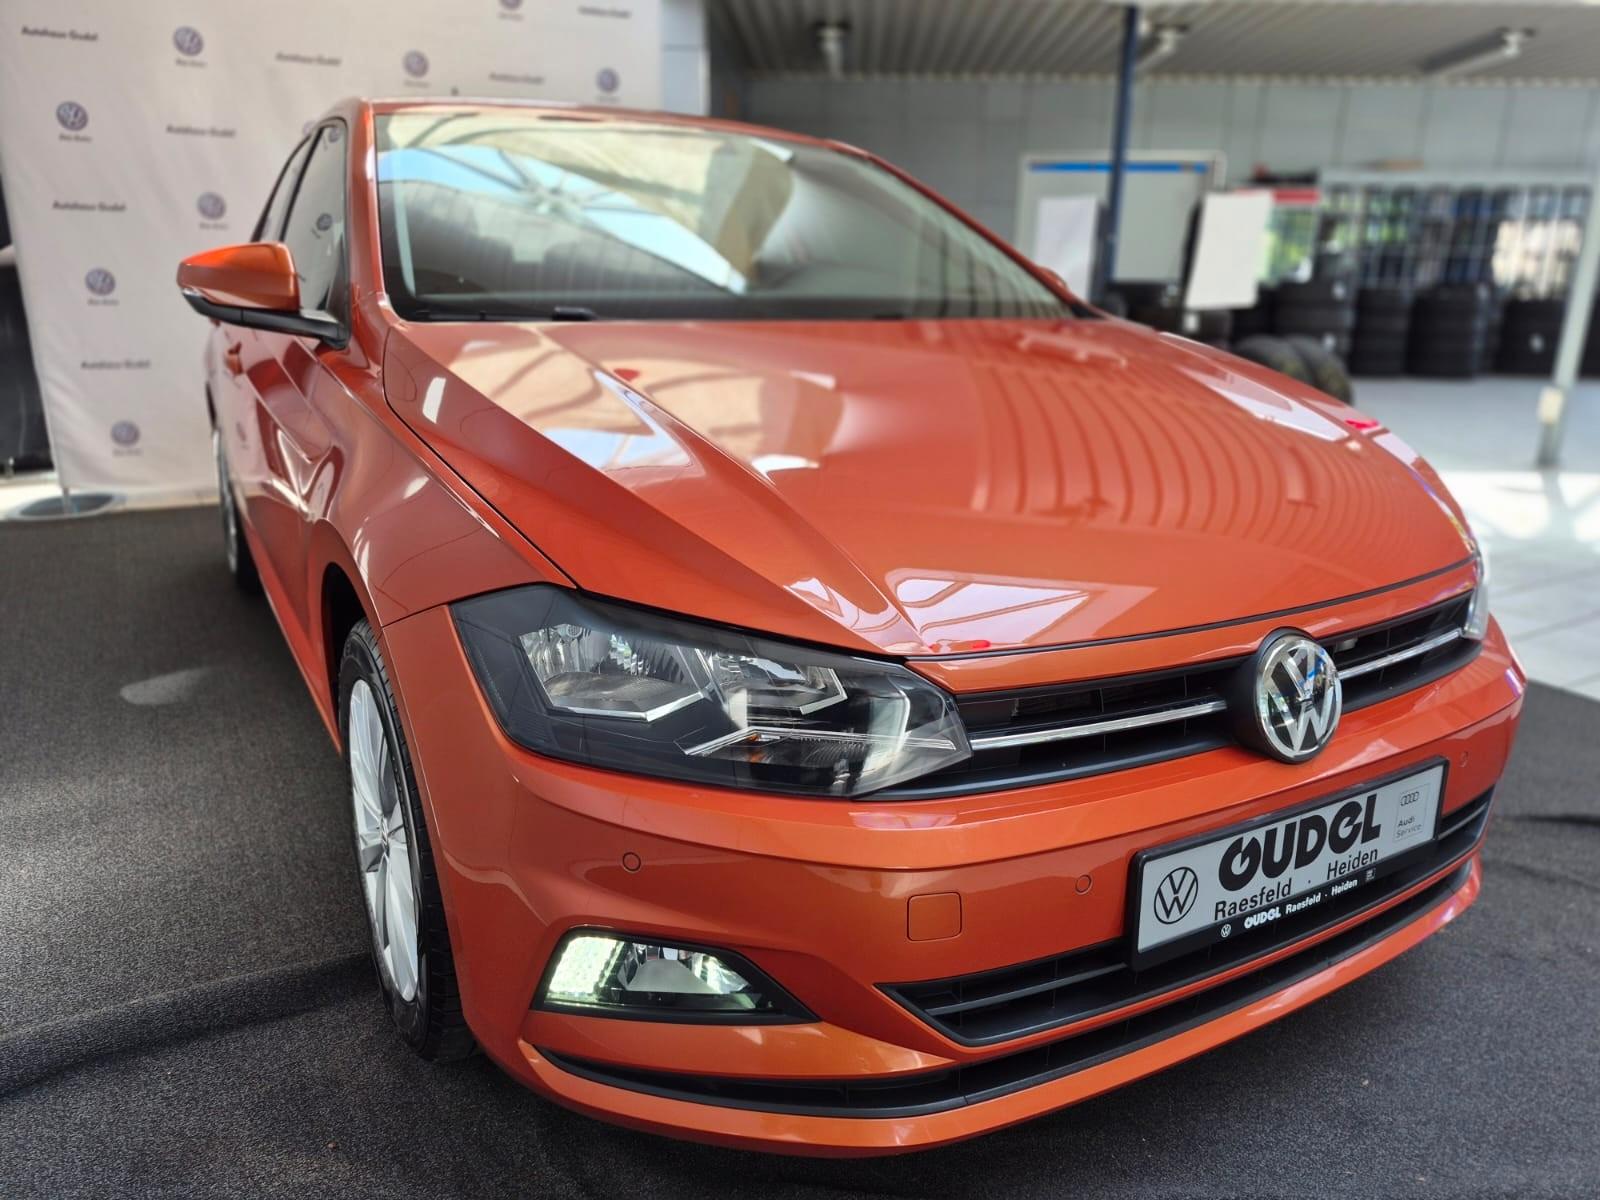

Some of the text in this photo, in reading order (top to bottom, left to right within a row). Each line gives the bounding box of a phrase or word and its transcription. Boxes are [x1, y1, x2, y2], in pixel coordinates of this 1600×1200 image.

[1396, 824, 1422, 838] Service
[1397, 816, 1415, 827] Audi
[1214, 848, 1378, 921] Raesfeld Heiden
[1285, 891, 1322, 916] Raesfeld
[1331, 878, 1358, 896] Heiden
